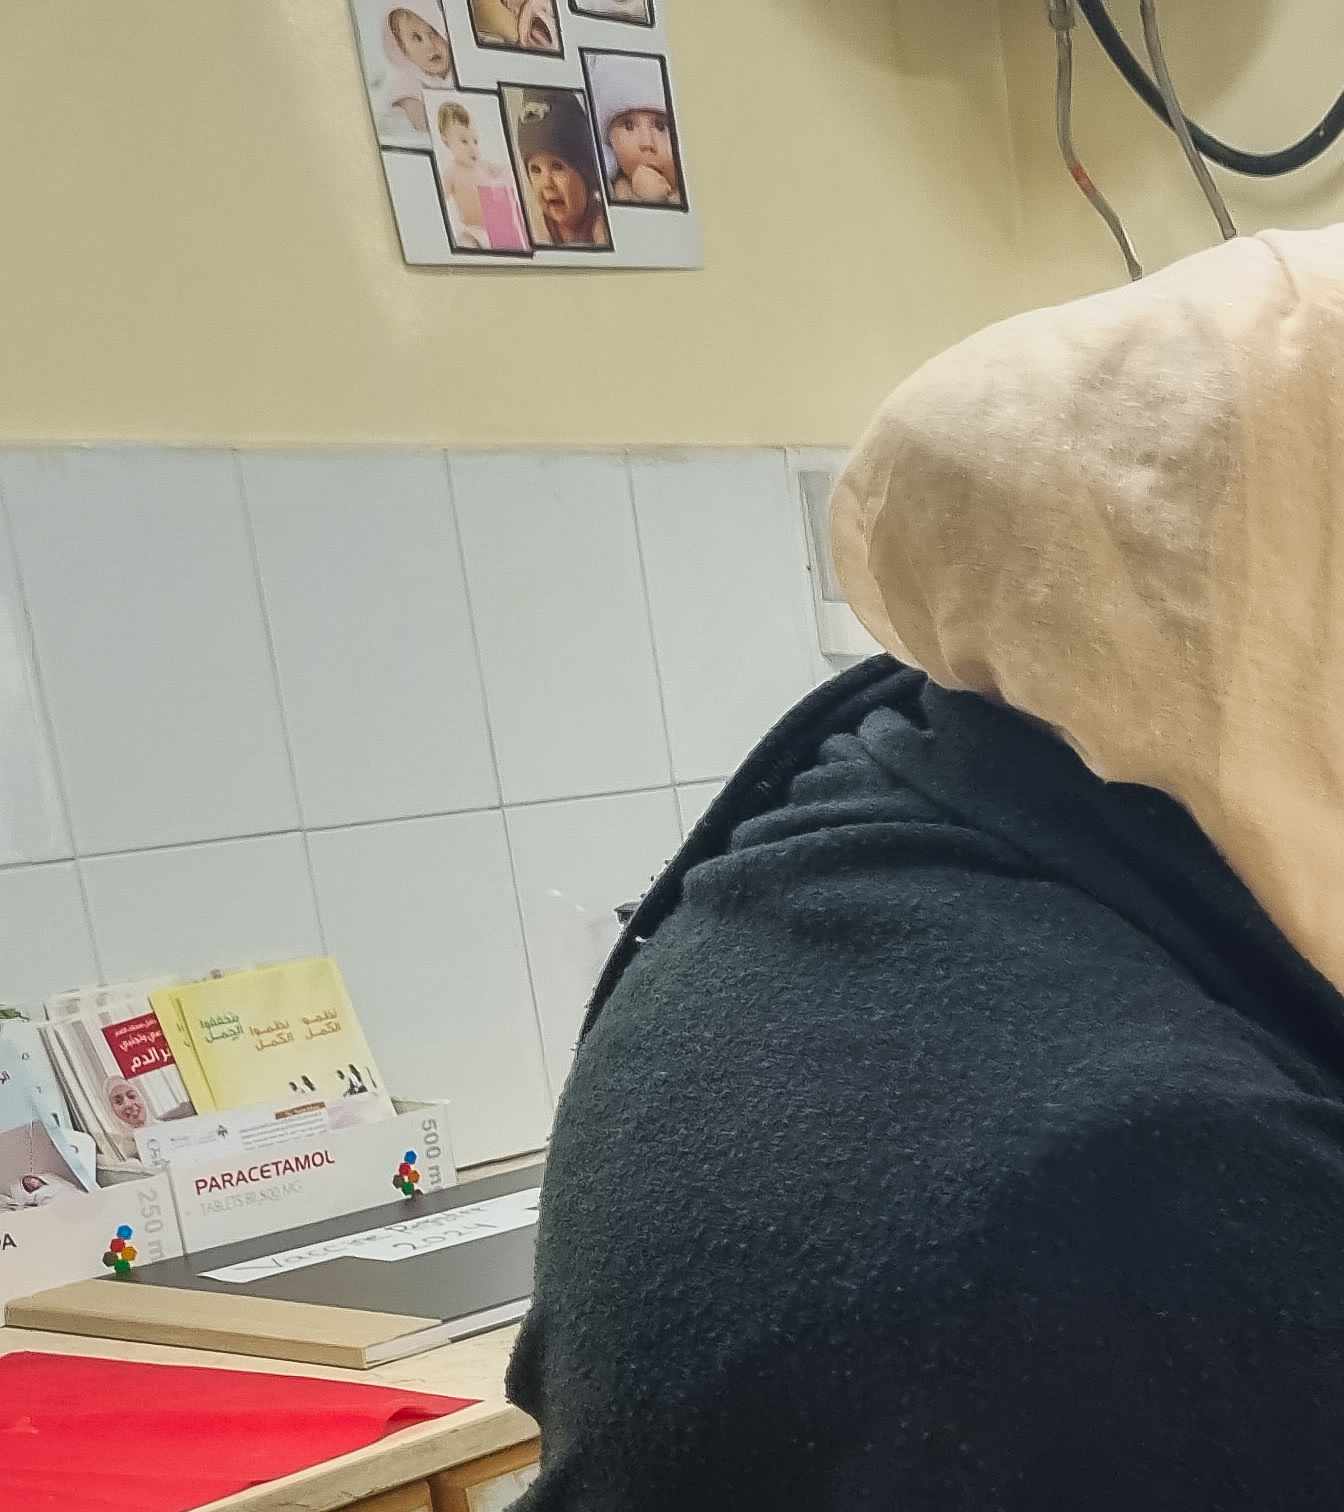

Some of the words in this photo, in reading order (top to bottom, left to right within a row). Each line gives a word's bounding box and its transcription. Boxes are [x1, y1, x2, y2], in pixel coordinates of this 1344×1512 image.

[421, 1118, 442, 1160] 500
[194, 1149, 336, 1196] PARACETAMOL
[392, 1222, 499, 1251] 2024
